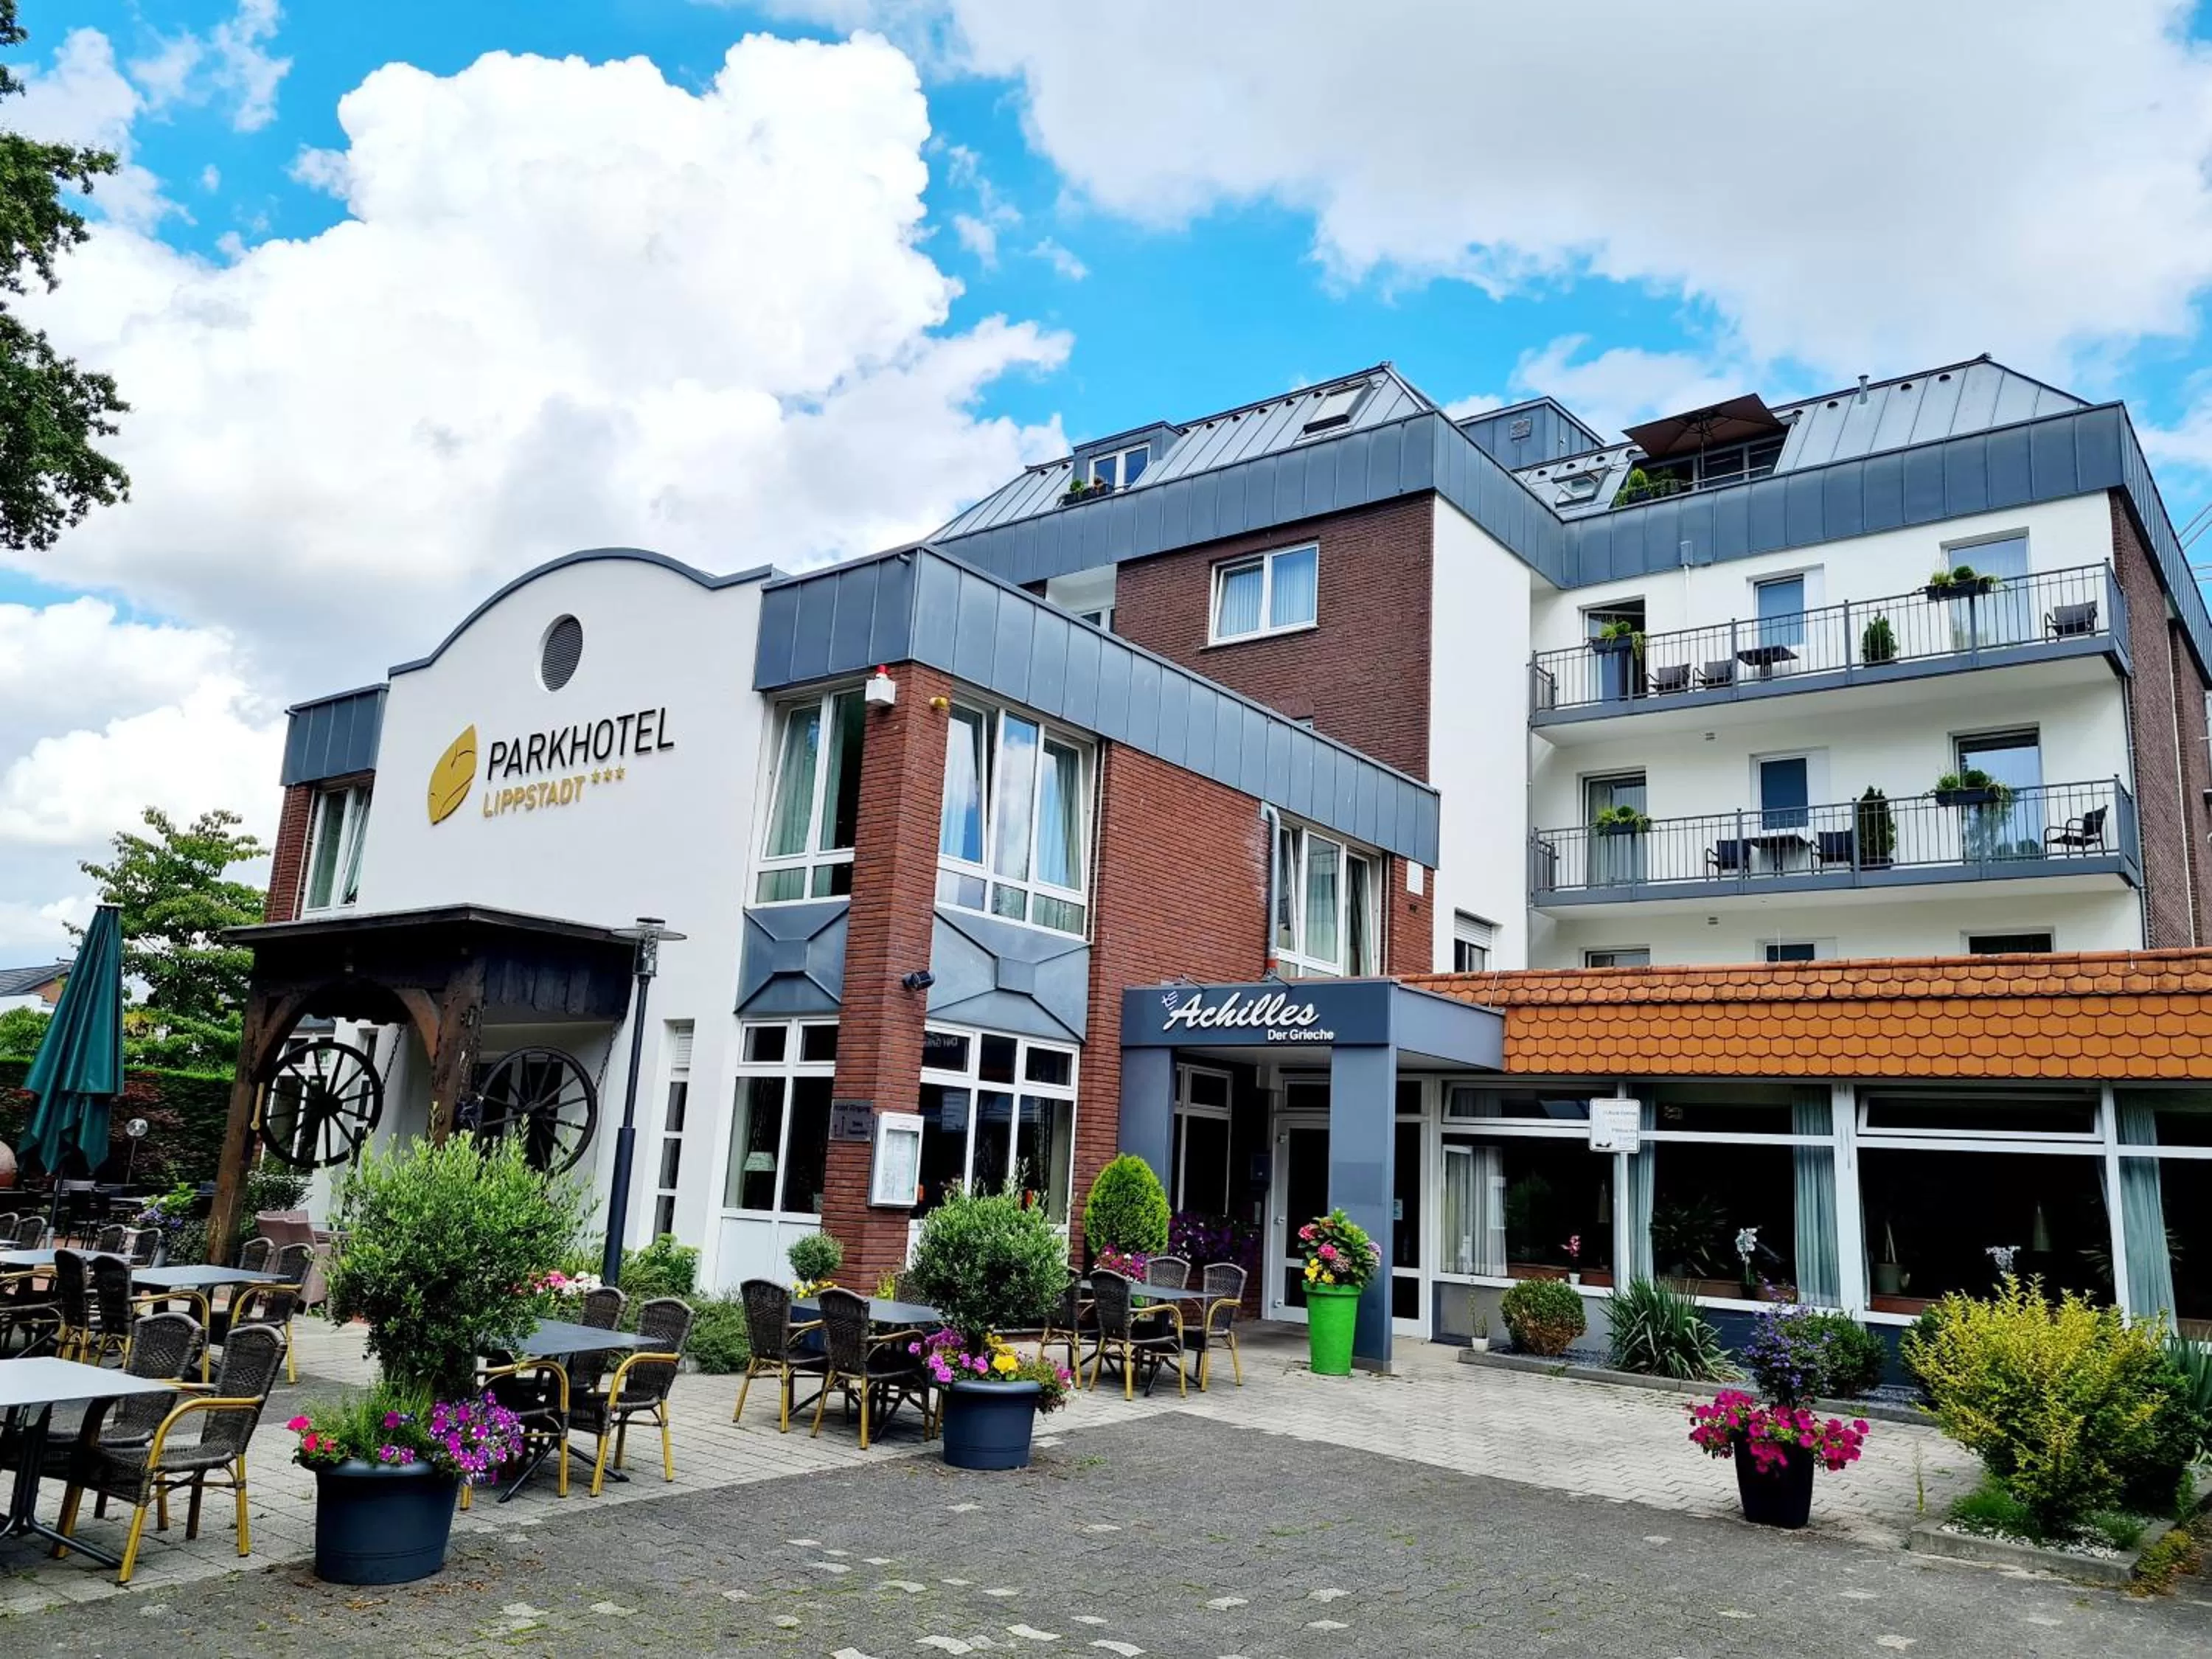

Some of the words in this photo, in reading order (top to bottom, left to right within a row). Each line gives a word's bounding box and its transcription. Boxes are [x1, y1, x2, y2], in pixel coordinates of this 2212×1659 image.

[487, 706, 674, 781] PARKHOTEL
[483, 775, 586, 818] LIPPSTADT
[1162, 992, 1319, 1030] Achilles
[1267, 1029, 1288, 1041] Der
[1290, 1029, 1334, 1041] Grieche
